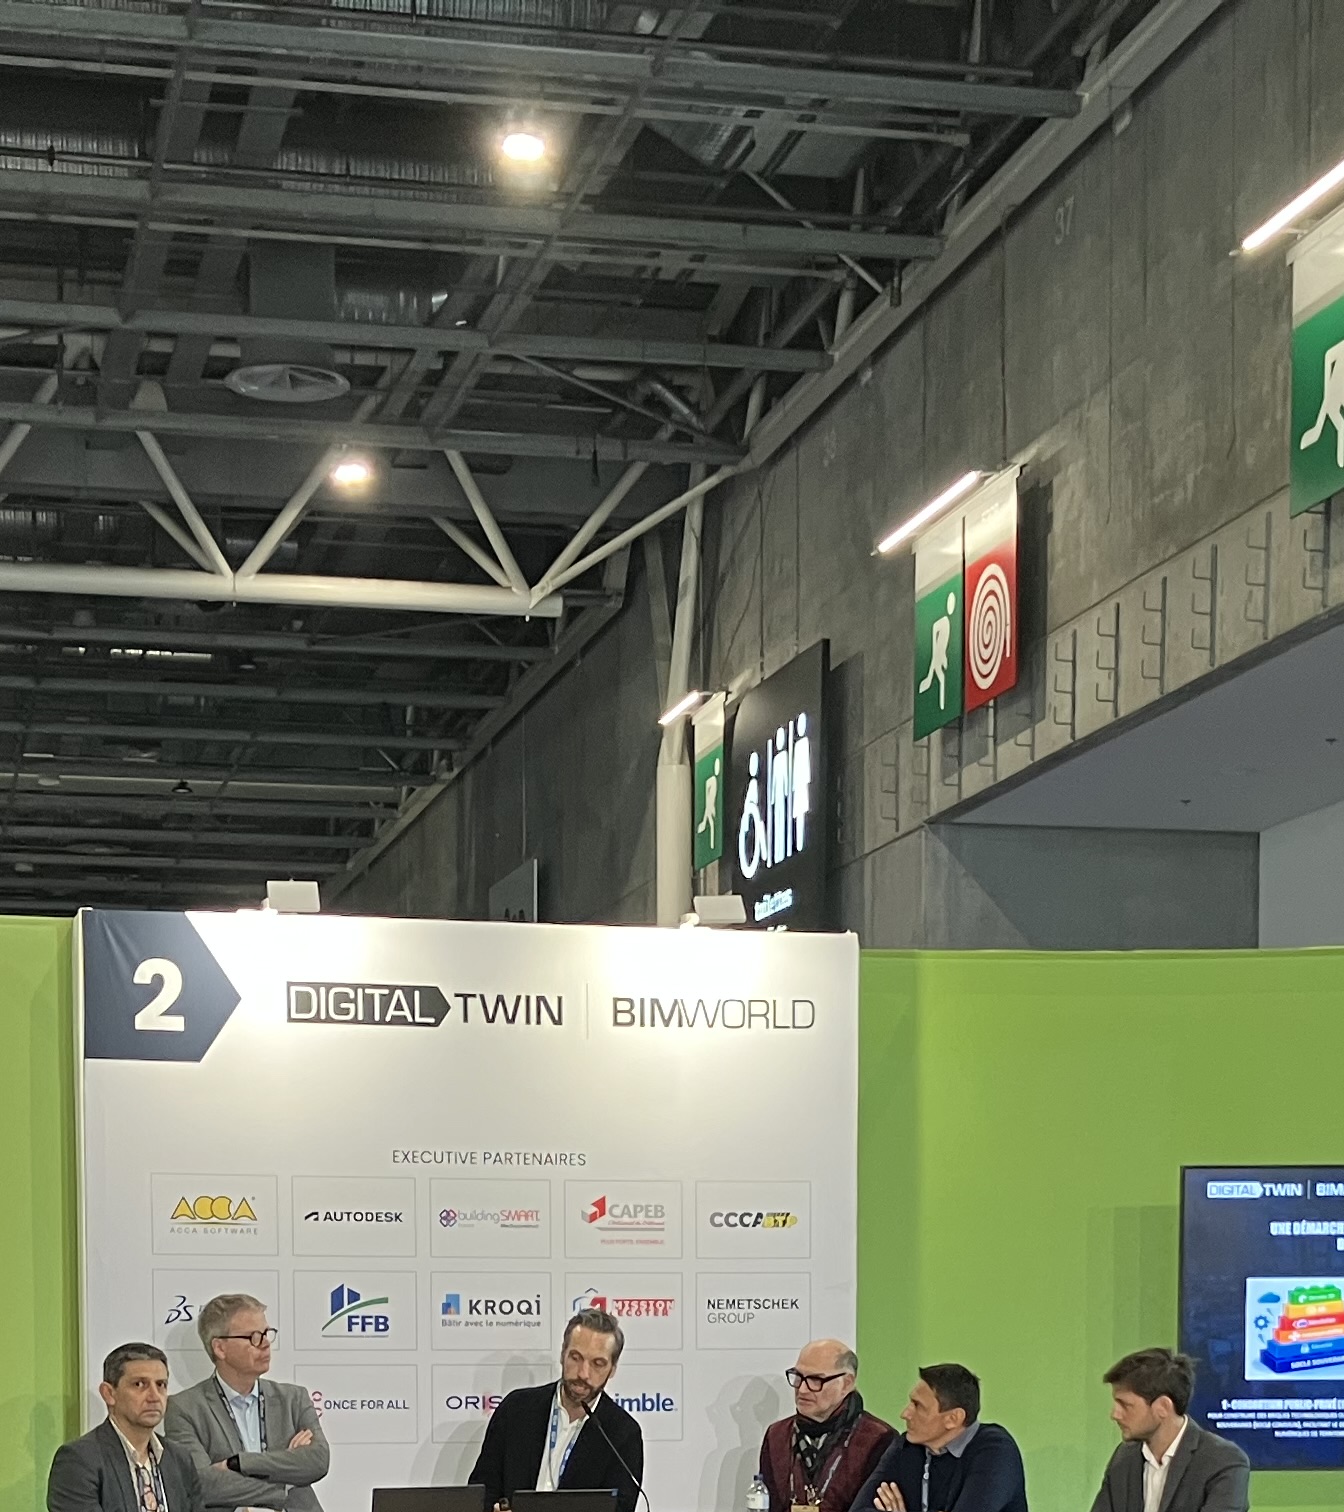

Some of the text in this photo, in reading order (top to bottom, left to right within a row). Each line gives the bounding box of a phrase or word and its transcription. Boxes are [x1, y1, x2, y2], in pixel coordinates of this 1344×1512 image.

[133, 957, 186, 1032] 2
[289, 985, 816, 1029] DIGITAL TWIN BIMWORLD
[392, 1150, 587, 1166] EXECUTIVE PARTENAIRES
[1208, 1184, 1258, 1196] DIGITAL
[1263, 1183, 1303, 1196] TWIN
[170, 1195, 258, 1221] ACCA
[608, 1204, 666, 1219] CAPEB
[323, 1211, 403, 1223] AUTODESK
[457, 1209, 541, 1225] buildingSMART
[169, 1227, 258, 1236] ACCA SOFTWARE
[1269, 1221, 1292, 1236] UNE
[613, 1299, 675, 1310] MISSION
[707, 1298, 800, 1310] NEMETSCHEK
[347, 1315, 390, 1333] FFB
[485, 1319, 494, 1327] le
[495, 1319, 542, 1328] numérique
[707, 1312, 755, 1324] GROUP
[324, 1399, 410, 1410] ONCE FOR ALL
[446, 1395, 503, 1410] ORIS
